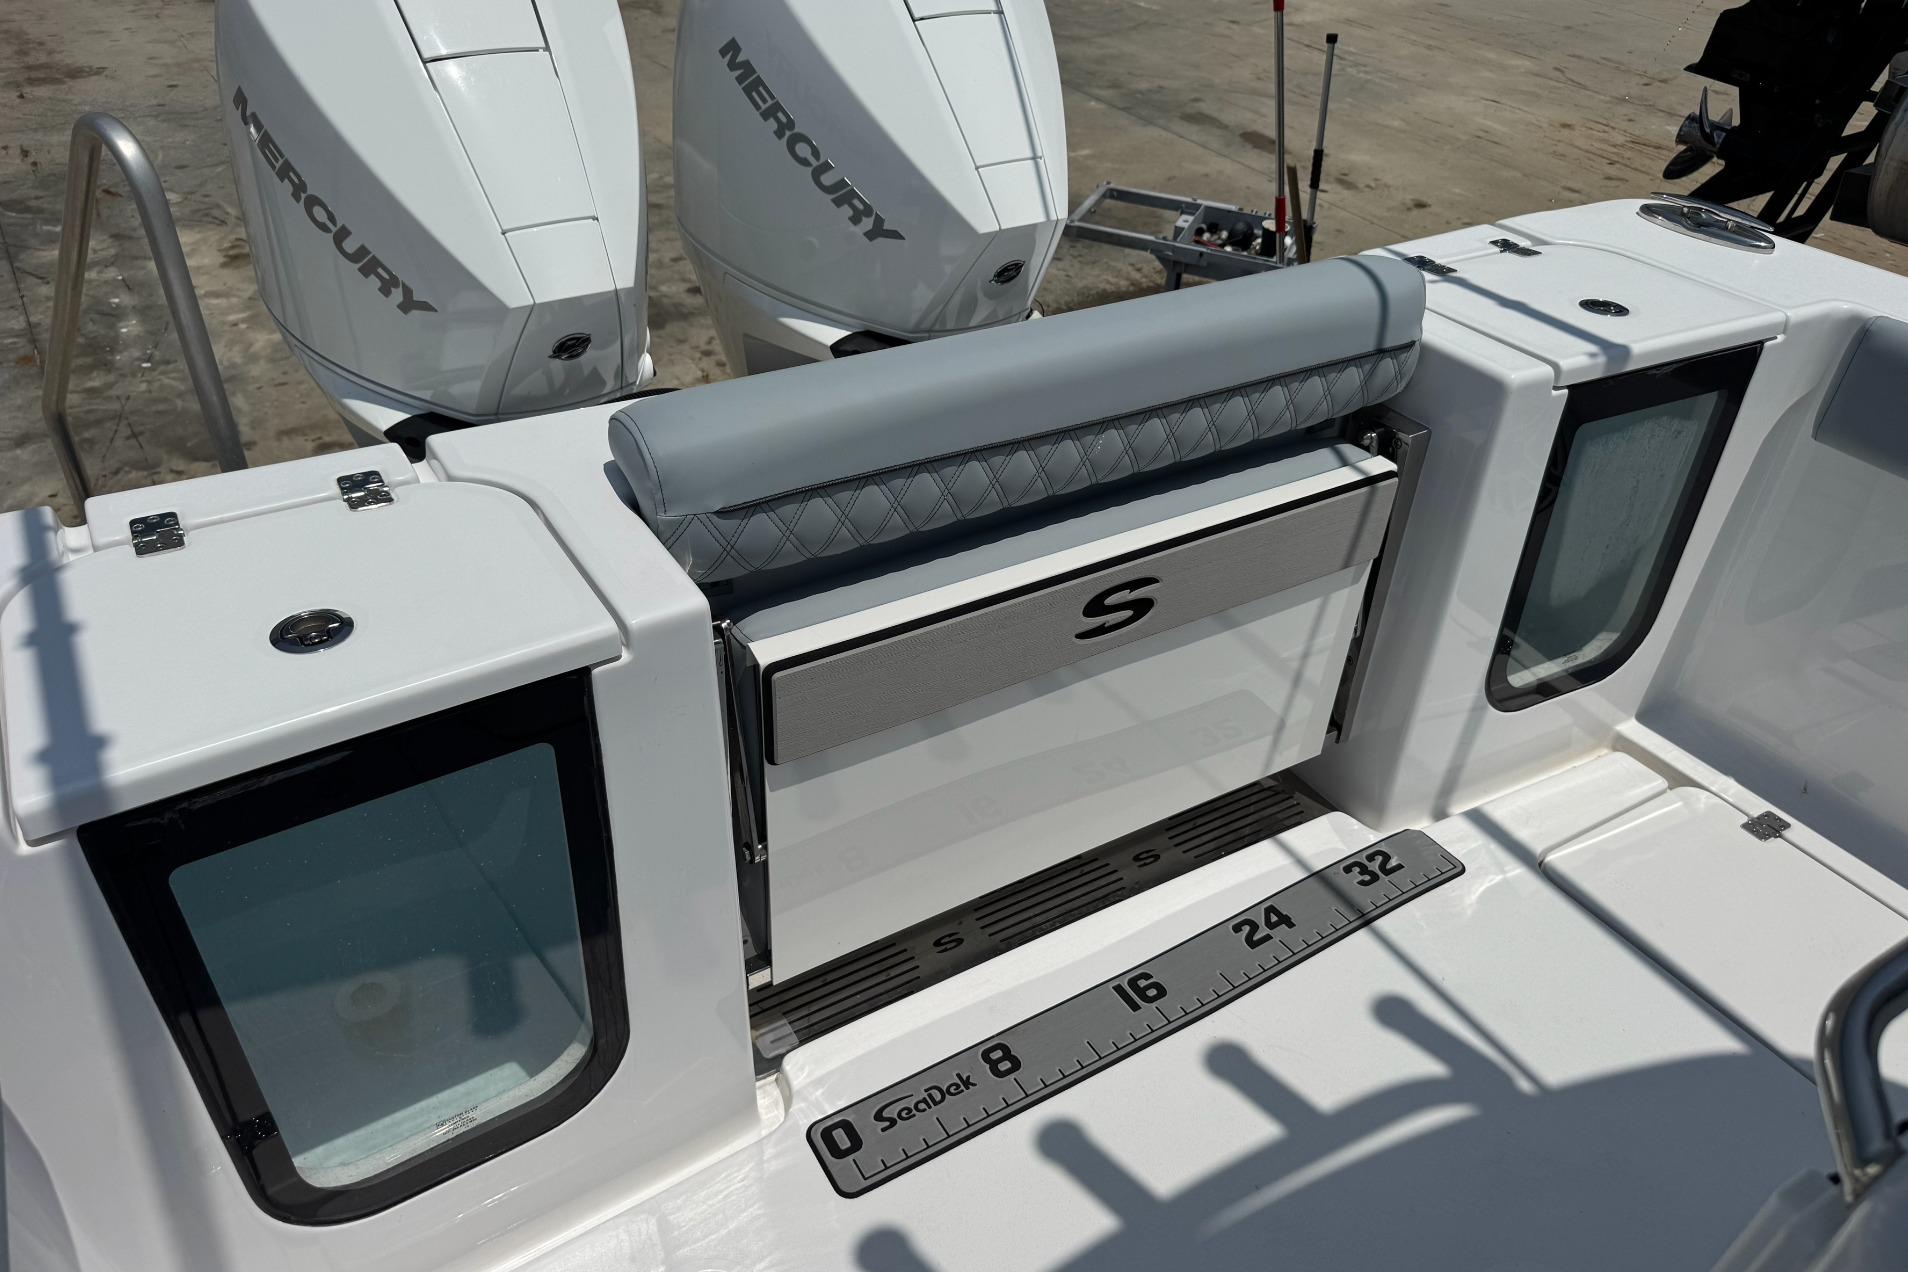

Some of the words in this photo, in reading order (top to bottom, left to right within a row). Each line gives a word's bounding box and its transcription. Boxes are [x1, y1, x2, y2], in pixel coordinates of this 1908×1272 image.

[232, 85, 438, 316] MERCURY
[718, 36, 906, 242] MERCURY
[1074, 576, 1160, 640] S
[820, 1118, 863, 1160] 0
[873, 1072, 978, 1133] SeaDek
[980, 1042, 1022, 1079] 8
[1111, 971, 1168, 1013] 16
[1231, 904, 1297, 950] 24
[1342, 849, 1405, 887] 32
